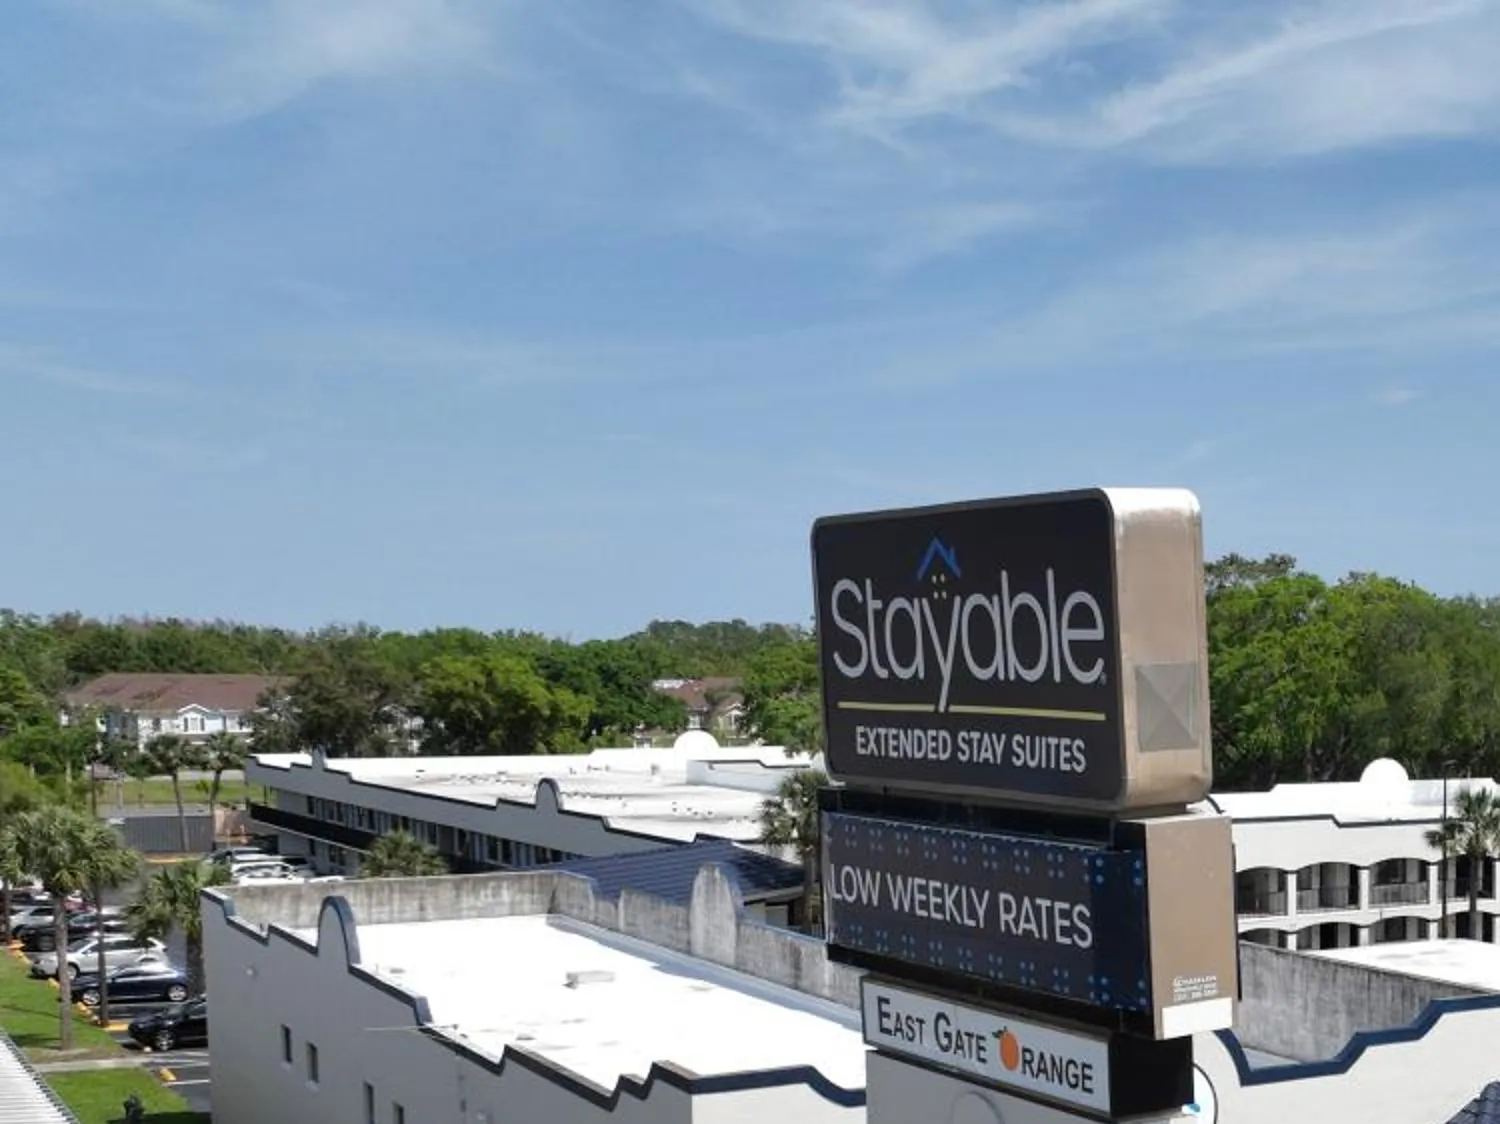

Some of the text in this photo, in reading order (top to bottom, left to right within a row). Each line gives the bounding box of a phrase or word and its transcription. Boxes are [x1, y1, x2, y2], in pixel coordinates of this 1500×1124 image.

[831, 568, 1104, 713] Stayable
[855, 725, 1086, 774] EXTENDED STAY SUITES
[829, 863, 1093, 949] LOW WEEKLY RATES
